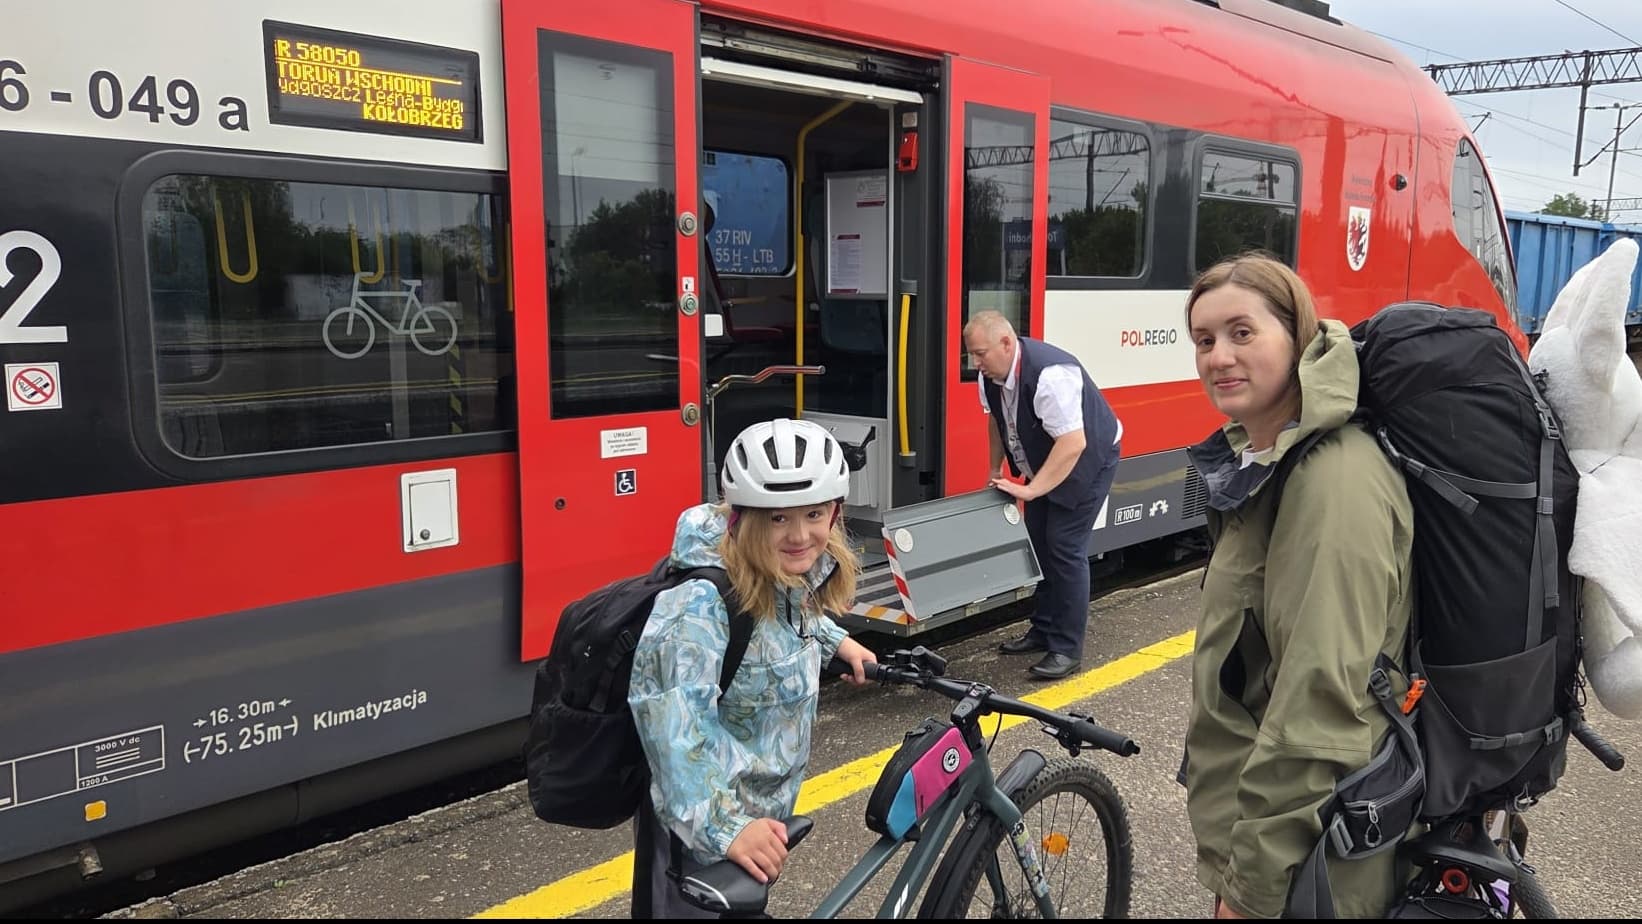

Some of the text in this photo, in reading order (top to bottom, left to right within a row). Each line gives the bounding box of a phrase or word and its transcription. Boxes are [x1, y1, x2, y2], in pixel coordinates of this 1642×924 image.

[277, 39, 360, 67] R 58050
[278, 61, 432, 97] TORUŃ WSCHODNI
[0, 60, 30, 111] 6
[88, 70, 200, 126] 049
[218, 96, 250, 132] a
[363, 103, 463, 130] KOŁOBRZEG
[732, 230, 752, 245] RIV
[715, 248, 730, 263] 55
[753, 248, 774, 263] LTB
[0, 230, 68, 343] 2
[1121, 328, 1177, 346] POLREGIO
[1123, 508, 1134, 520] 100
[313, 689, 427, 730] Klimatyzacja
[95, 736, 140, 752] 3000 V dc
[81, 777, 100, 787] 1200
